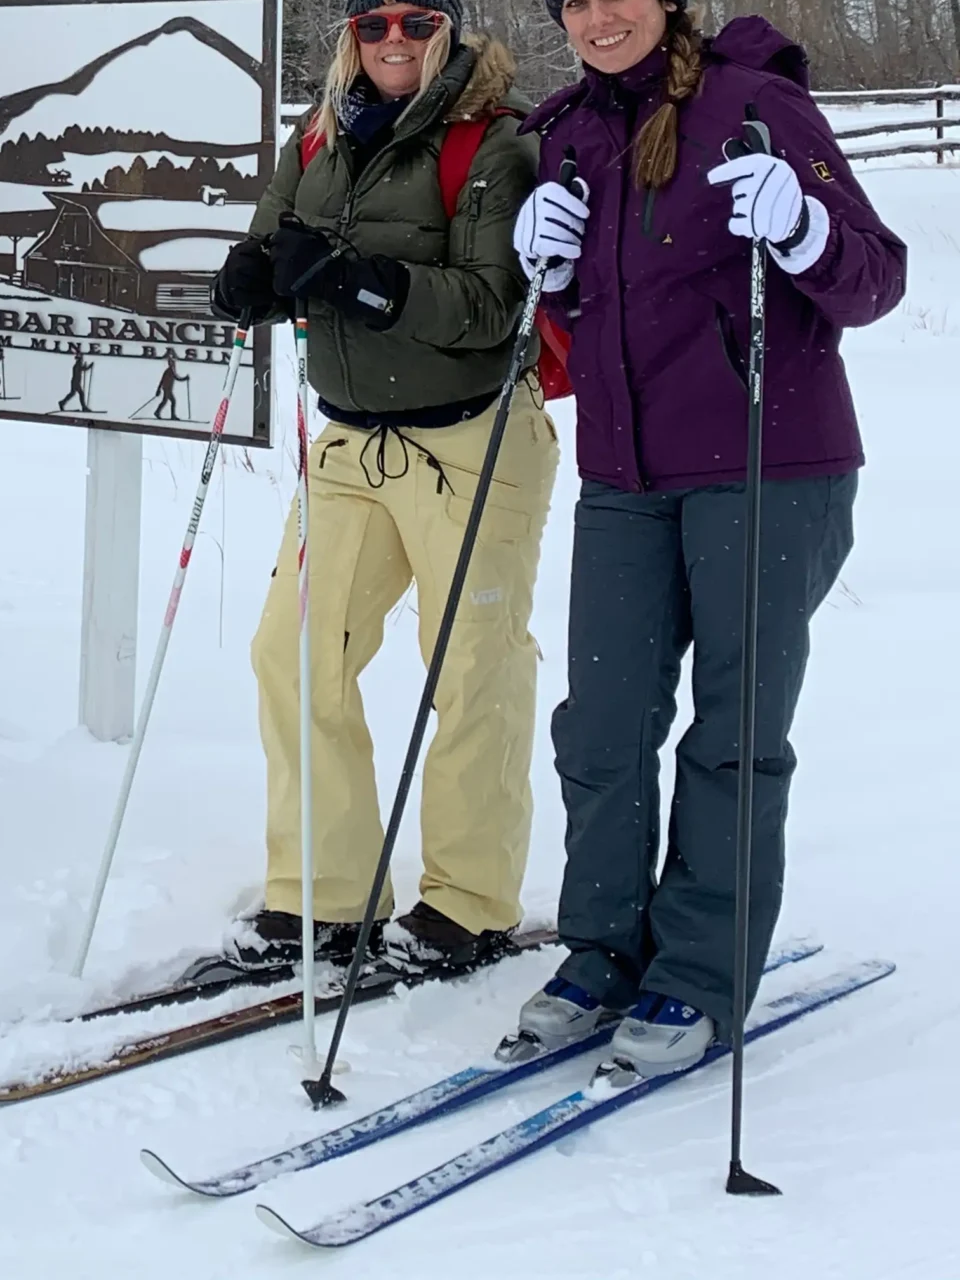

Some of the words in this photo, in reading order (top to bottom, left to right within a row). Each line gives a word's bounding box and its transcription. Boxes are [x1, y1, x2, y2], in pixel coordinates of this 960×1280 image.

[88, 317, 236, 348] RANCH
[30, 337, 123, 356] MINER
[141, 345, 235, 365] BASIN
